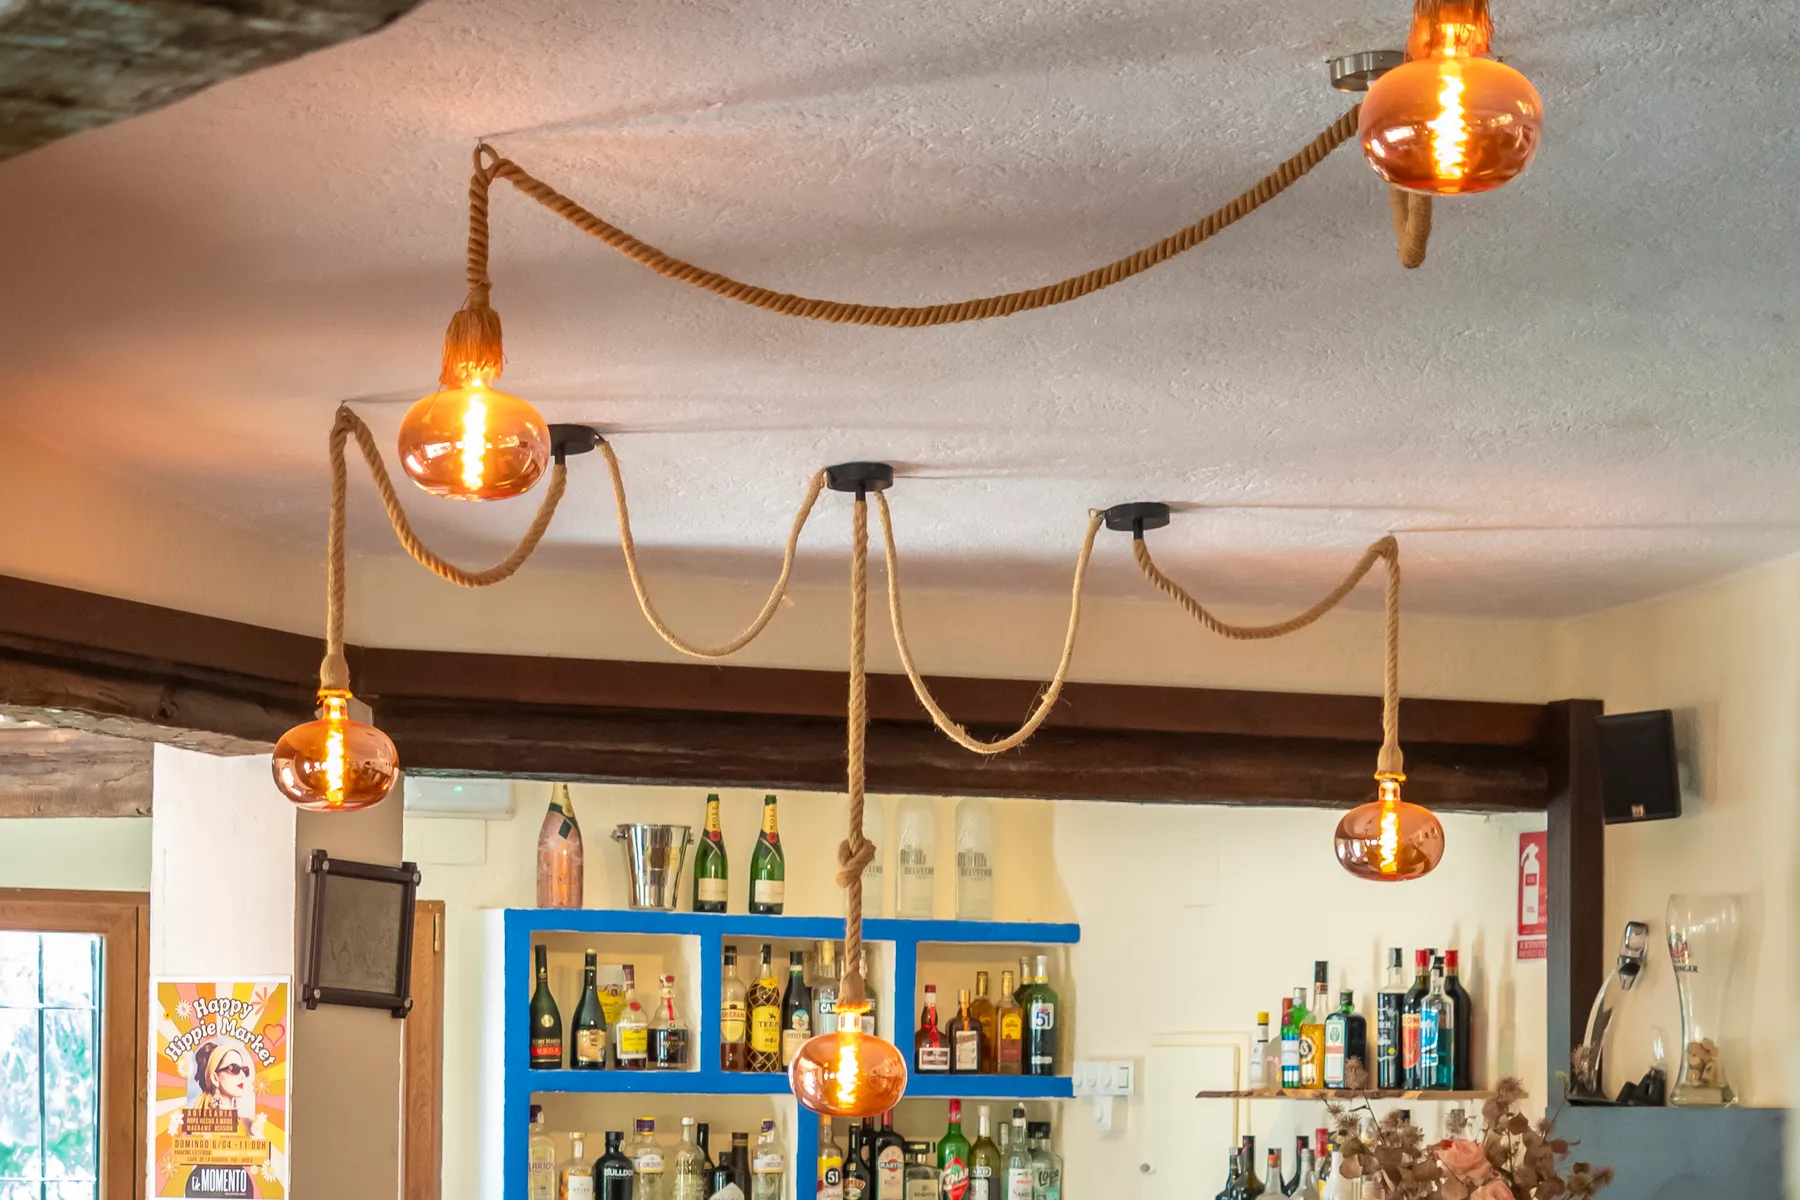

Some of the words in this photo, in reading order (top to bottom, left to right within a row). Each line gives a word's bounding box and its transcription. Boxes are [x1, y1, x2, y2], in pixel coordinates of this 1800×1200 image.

[192, 997, 254, 1019] Happy
[1035, 1012, 1051, 1028] 51
[164, 1020, 217, 1062] Hippie
[220, 1016, 276, 1067] Market
[174, 1140, 209, 1149] DOMINGO
[201, 1168, 247, 1192] MOMENTO
[827, 1170, 840, 1184] 51
